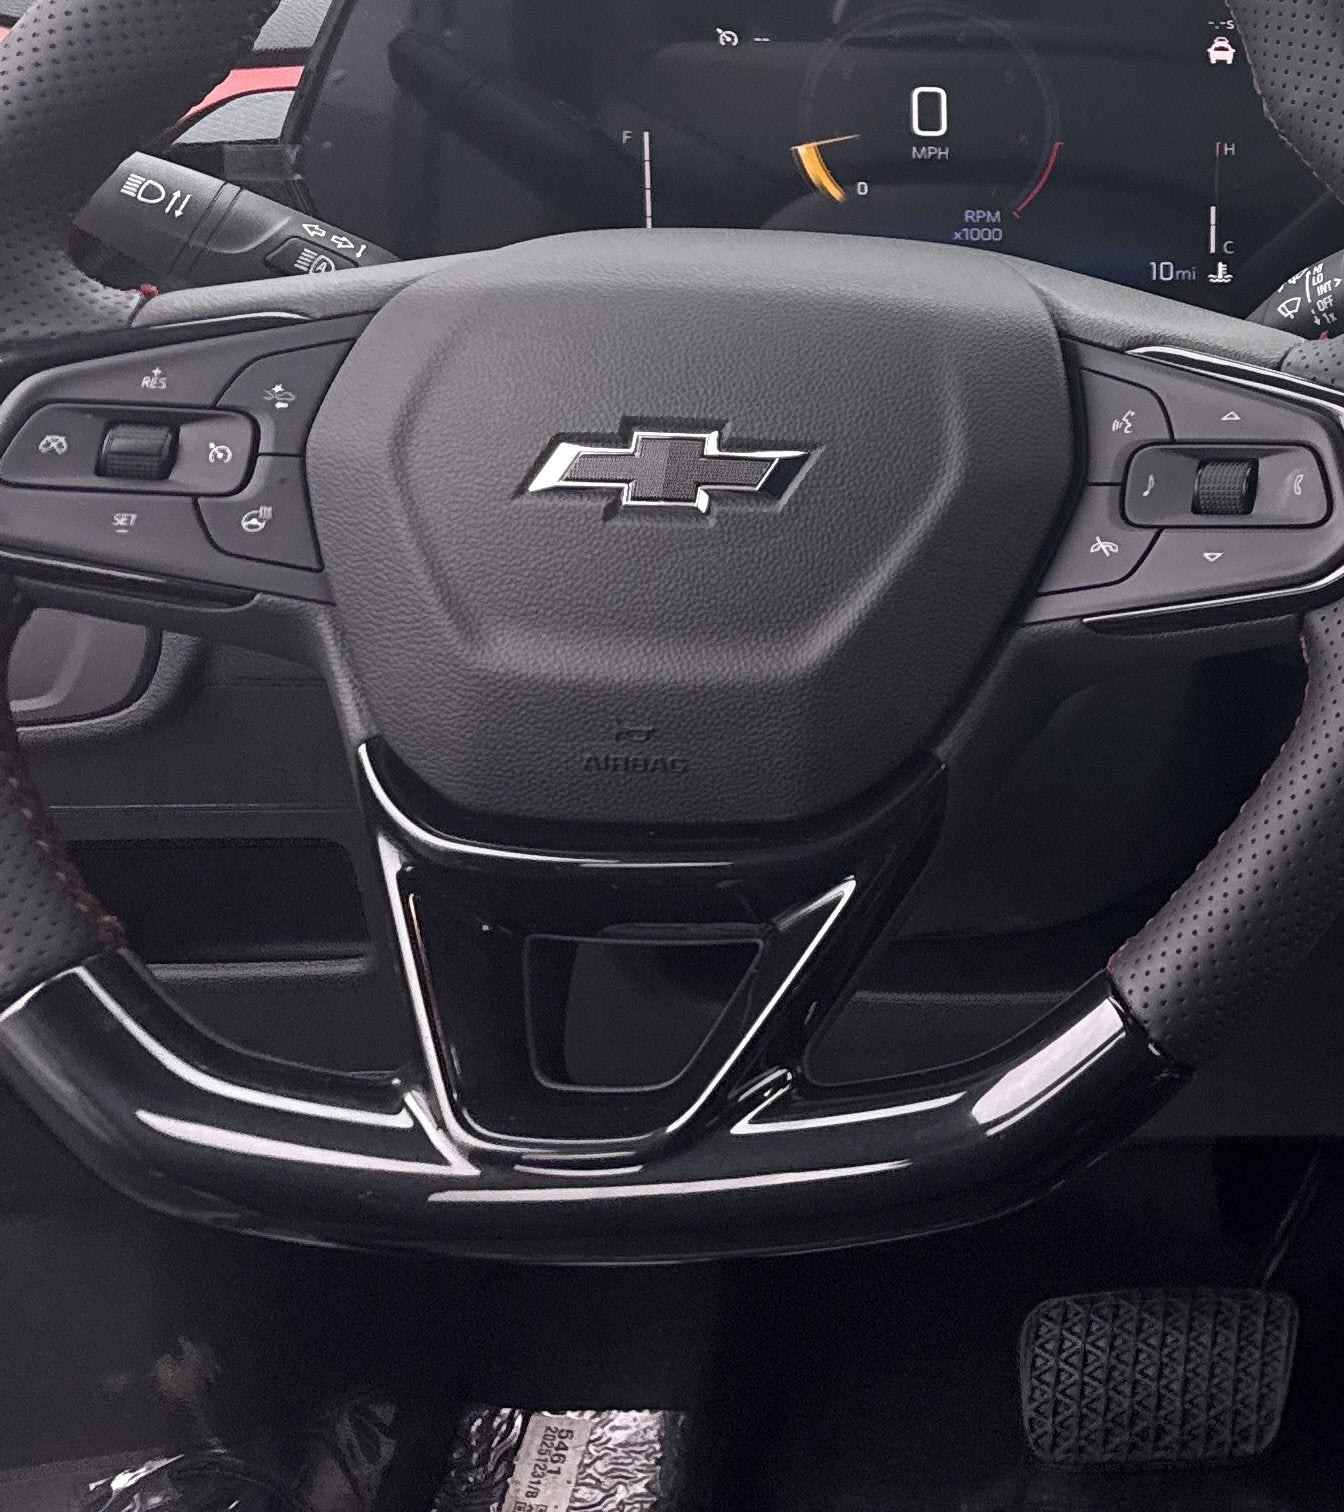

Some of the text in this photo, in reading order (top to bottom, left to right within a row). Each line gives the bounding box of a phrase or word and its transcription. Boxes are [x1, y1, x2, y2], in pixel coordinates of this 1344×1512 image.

[912, 86, 947, 137] 0
[622, 130, 633, 144] F
[911, 146, 950, 160] MPH
[1223, 142, 1236, 156] H
[964, 209, 1002, 223] RPM
[953, 227, 1003, 242] x1000
[1223, 240, 1235, 255] C
[1312, 273, 1324, 286] LO
[1316, 280, 1332, 296] INT
[1316, 295, 1334, 312] OFF
[112, 512, 138, 526] SET
